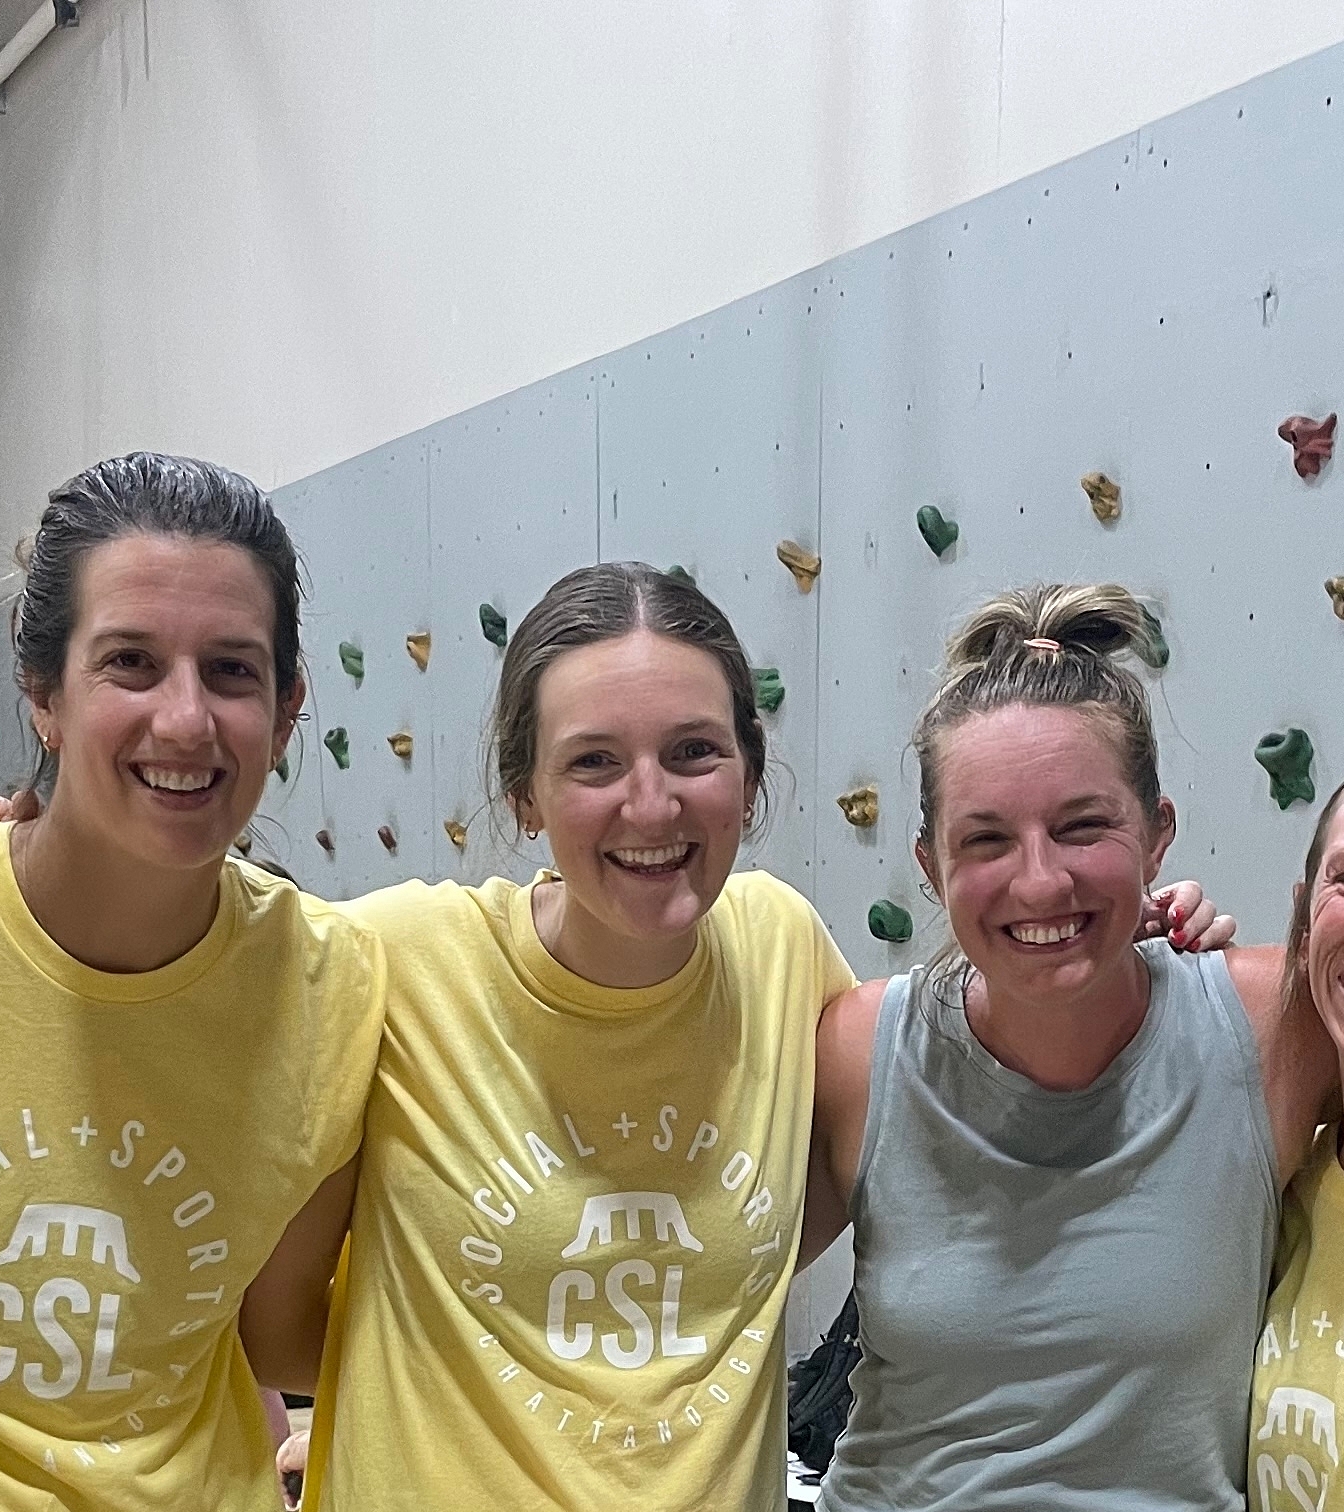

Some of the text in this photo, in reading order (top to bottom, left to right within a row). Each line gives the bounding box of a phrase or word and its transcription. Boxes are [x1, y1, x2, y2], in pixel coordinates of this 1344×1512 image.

[110, 1120, 230, 1337] SPORTS
[461, 1113, 595, 1305] SOCIAL
[652, 1105, 781, 1298] SPORTS
[478, 1325, 766, 1449] CHATTANOOGA
[547, 1259, 708, 1370] CSL
